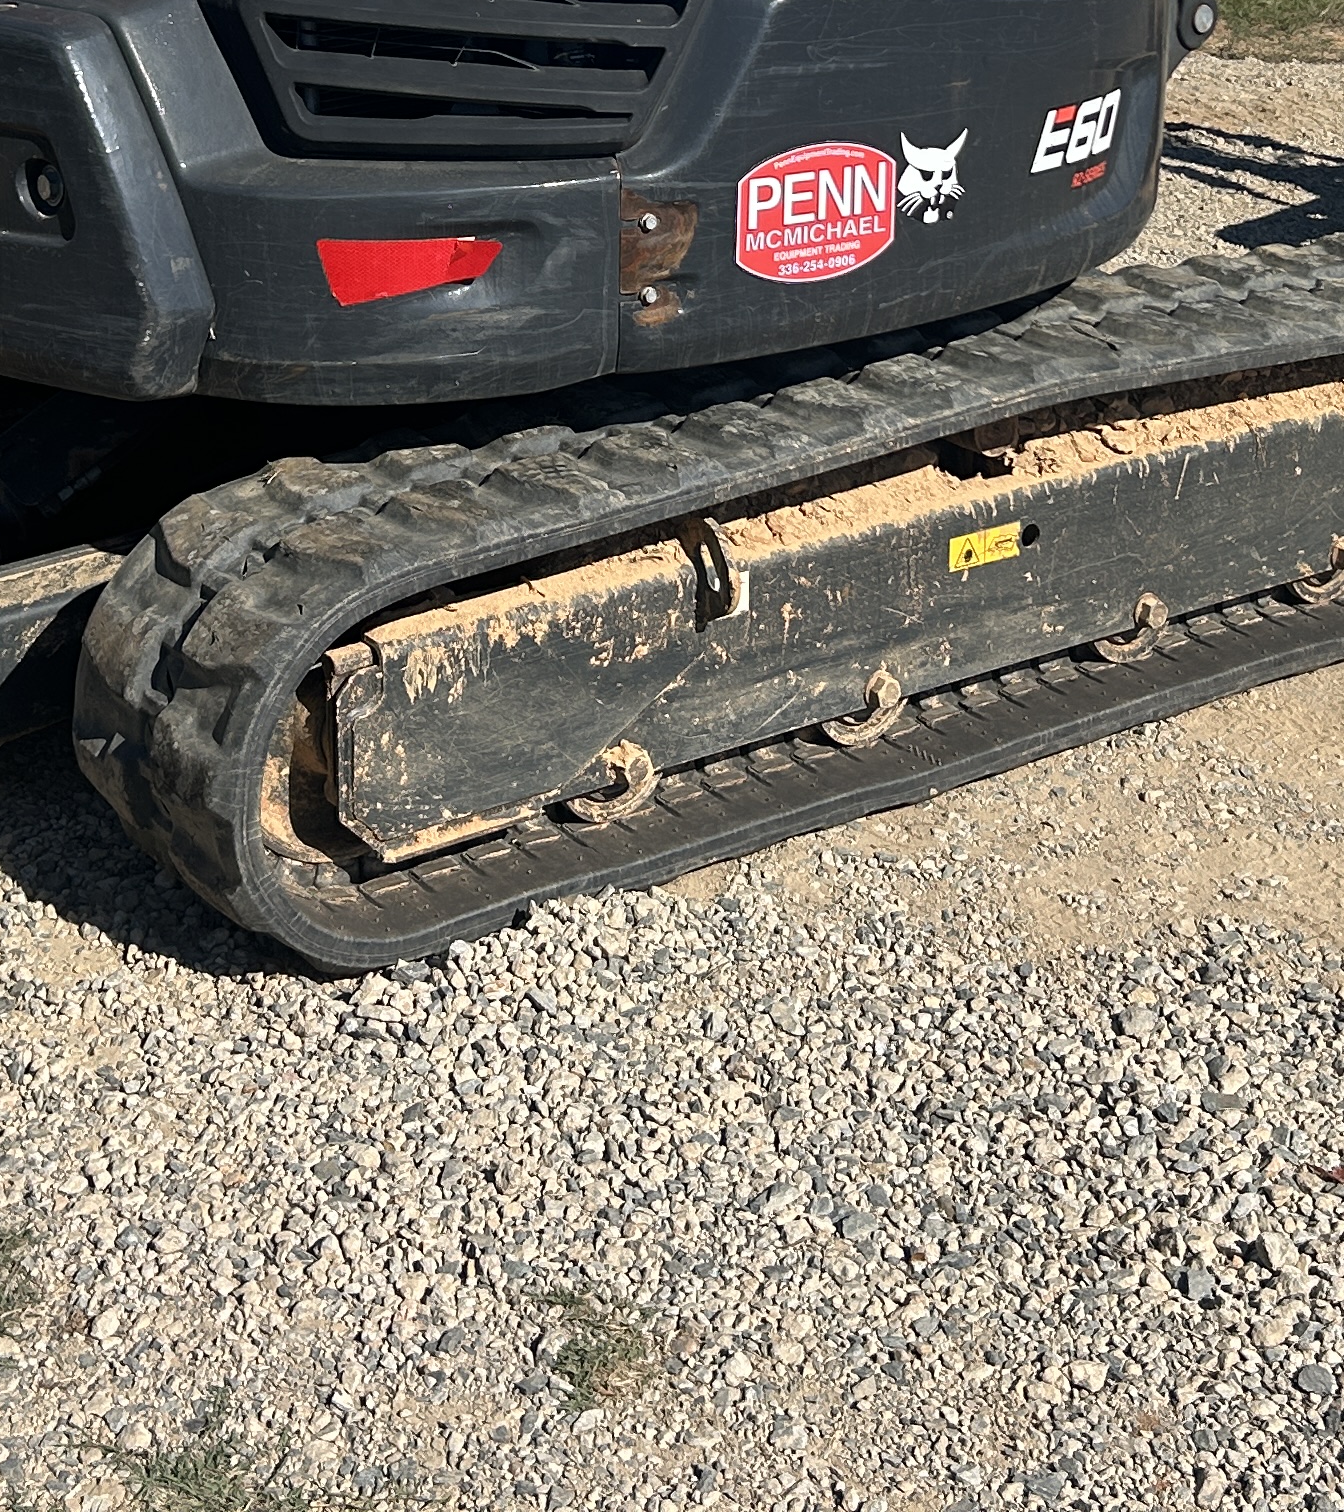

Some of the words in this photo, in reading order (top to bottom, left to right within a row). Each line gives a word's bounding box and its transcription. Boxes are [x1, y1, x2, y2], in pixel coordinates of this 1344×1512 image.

[1030, 88, 1122, 174] E60
[747, 161, 887, 230] PENN
[745, 215, 887, 252] MCMICHAEL
[773, 245, 824, 262] EQUIPMENT
[825, 239, 861, 254] TRADING
[777, 253, 856, 277] 336-254-0906
